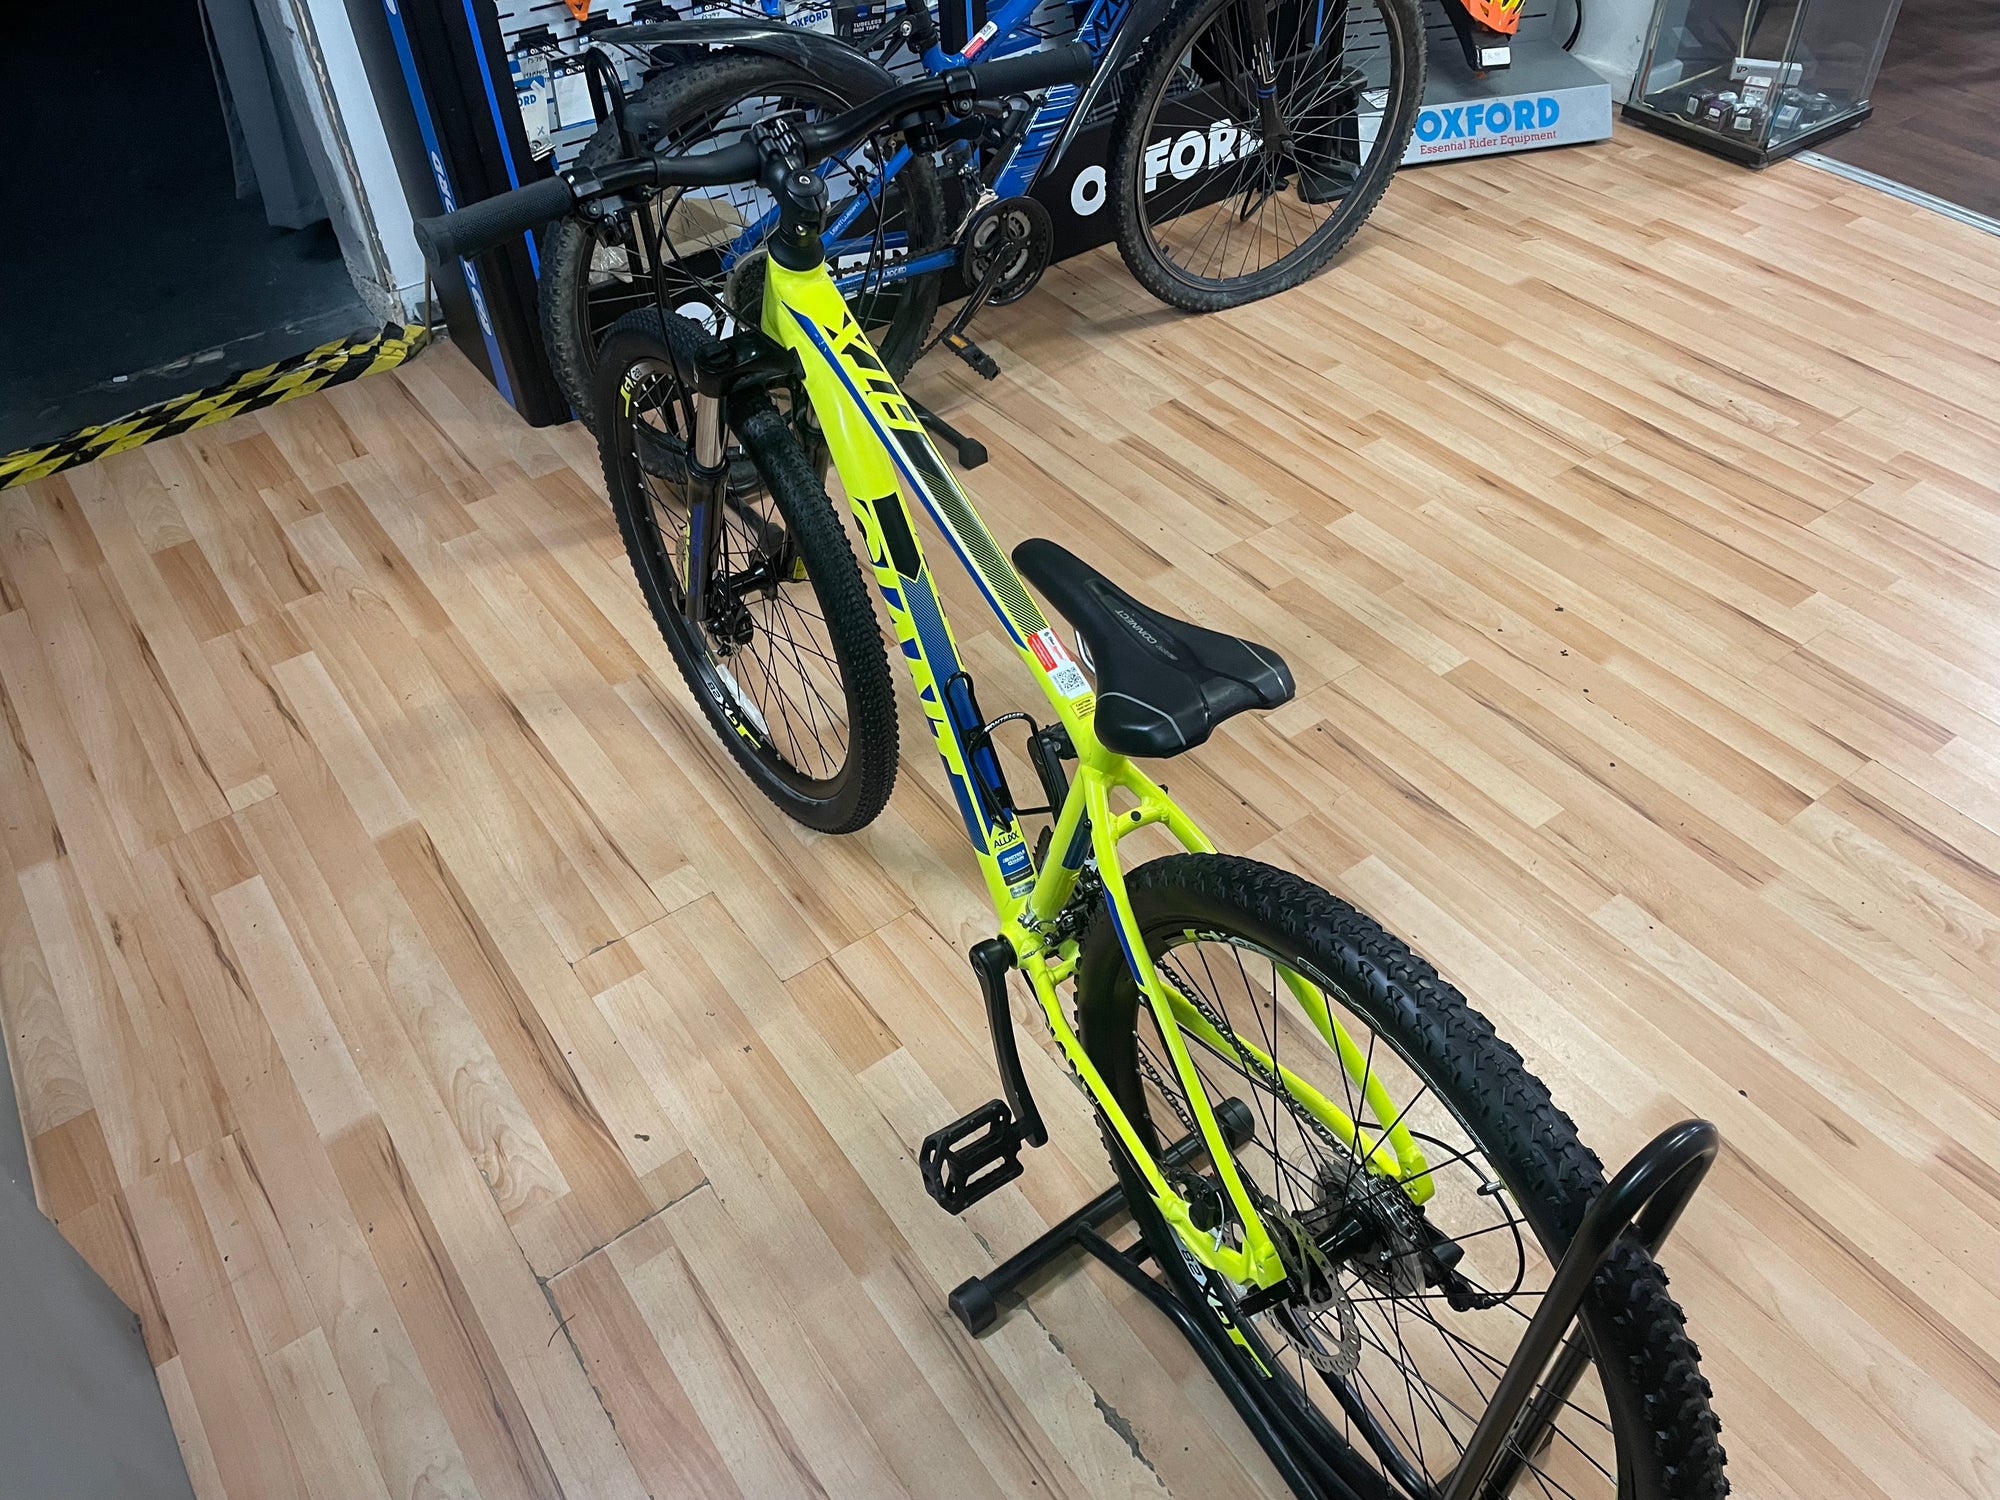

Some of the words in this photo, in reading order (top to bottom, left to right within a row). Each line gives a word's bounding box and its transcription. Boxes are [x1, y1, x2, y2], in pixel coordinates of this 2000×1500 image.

[852, 18, 882, 29] TUBELESS
[852, 26, 865, 34] RIM
[865, 23, 880, 32] TAPE
[1415, 97, 1560, 142] OXFORD
[1419, 140, 1467, 155] Essential
[1469, 137, 1497, 149] Rider
[1500, 130, 1557, 147] Equipment
[1114, 608, 1158, 645] CONNECT
